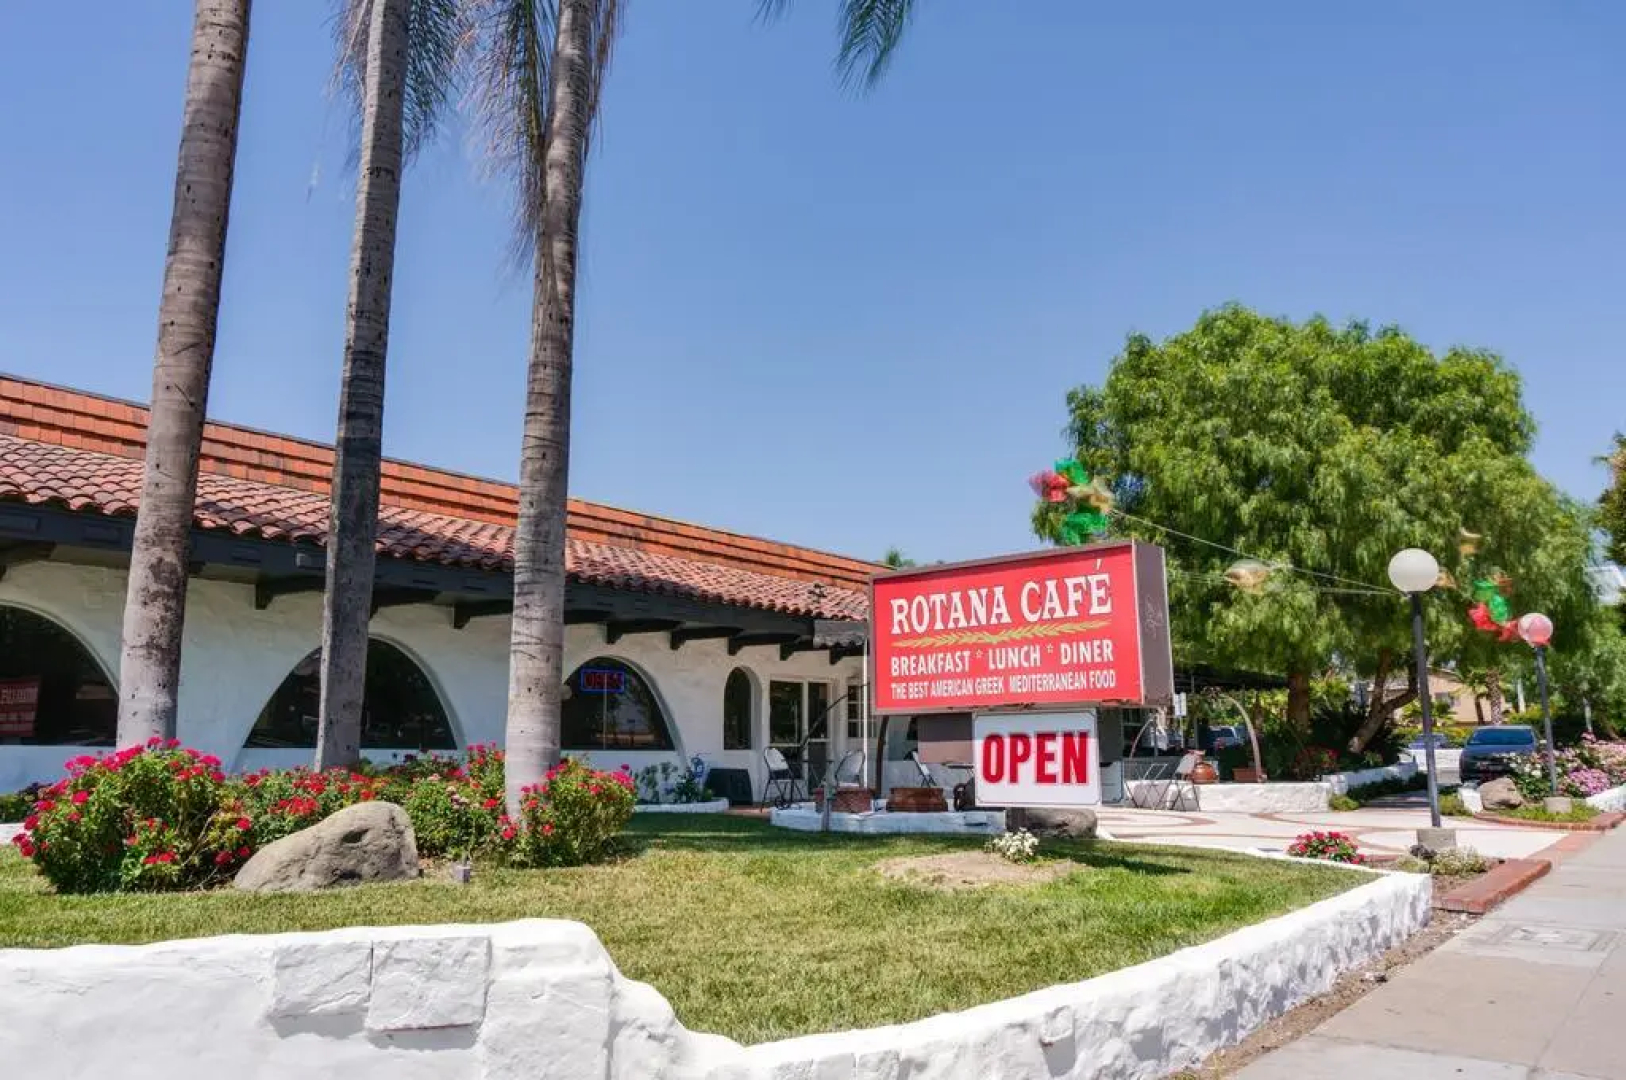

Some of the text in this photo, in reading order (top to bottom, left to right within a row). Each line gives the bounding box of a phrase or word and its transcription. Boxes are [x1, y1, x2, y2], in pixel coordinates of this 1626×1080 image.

[890, 559, 1113, 634] ROTANA CAFÉ
[891, 639, 1114, 677] BREAKFAST LUNCH DINER
[891, 669, 1116, 699] THE BEST AMERICAN GREEK MEDITERRANEAN FOOD
[981, 730, 1089, 785] OPEN
